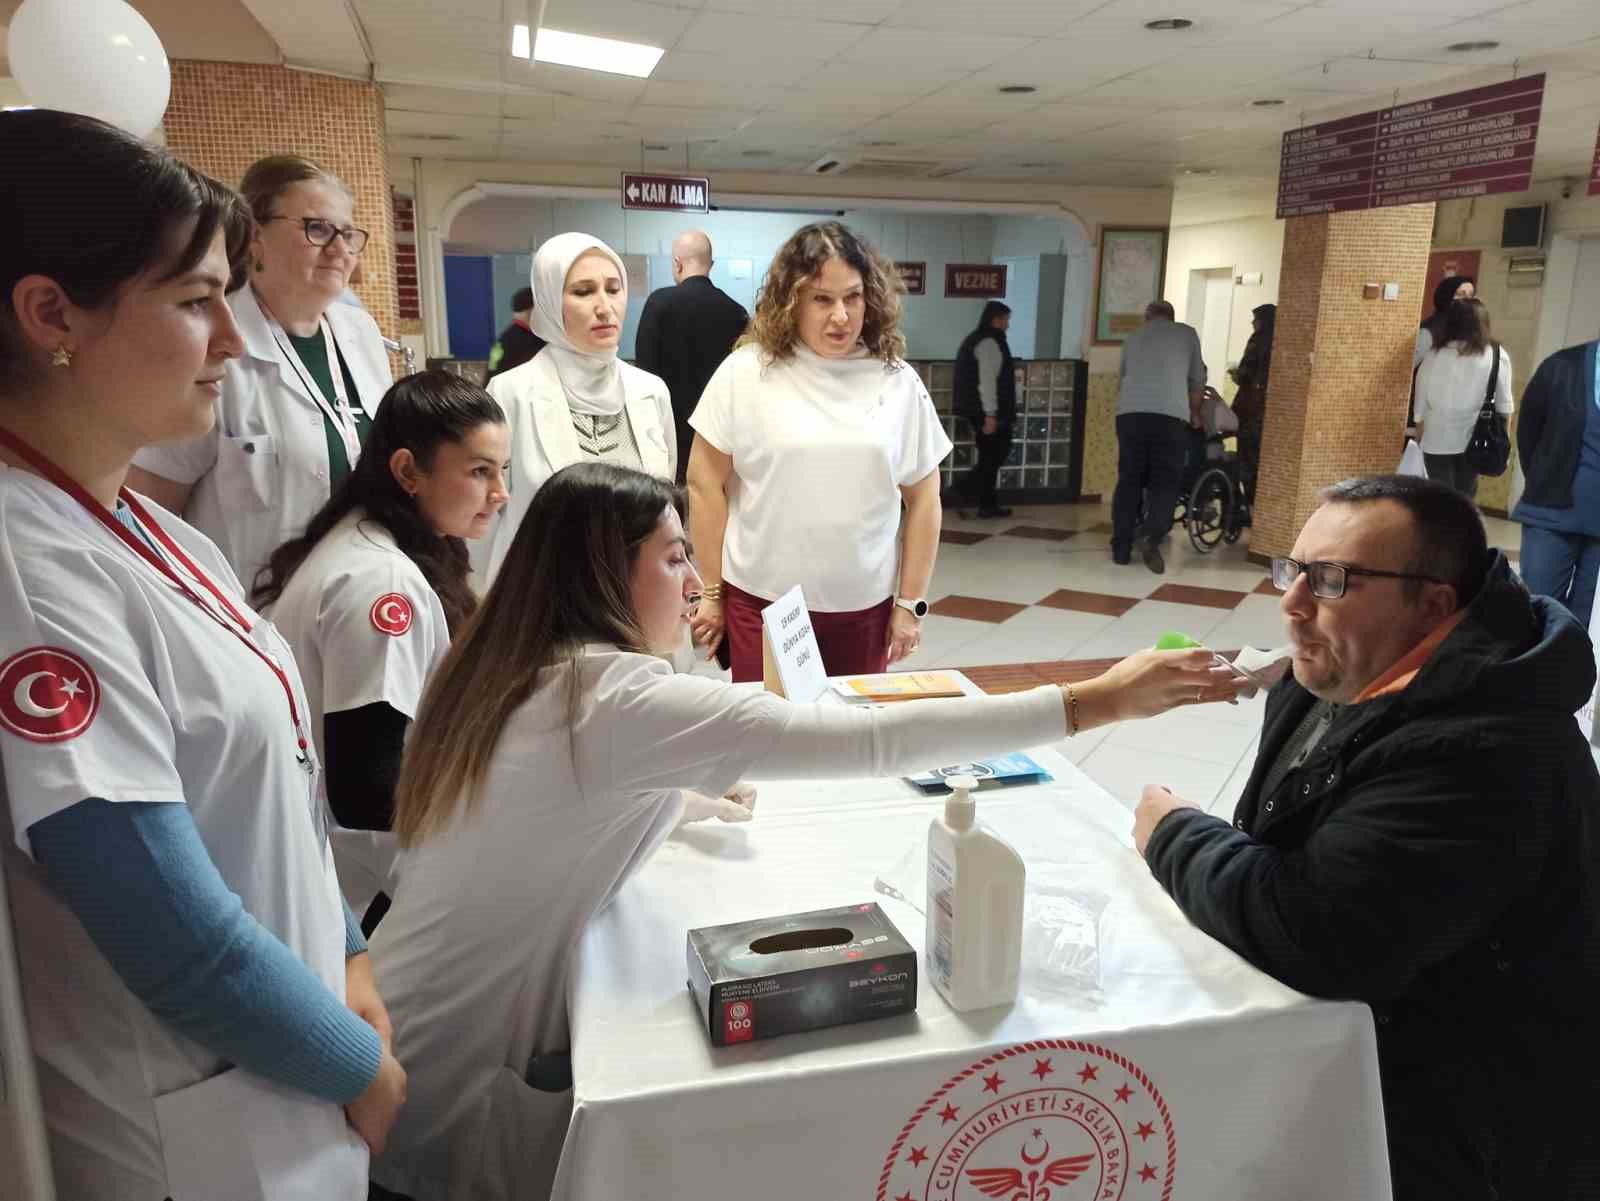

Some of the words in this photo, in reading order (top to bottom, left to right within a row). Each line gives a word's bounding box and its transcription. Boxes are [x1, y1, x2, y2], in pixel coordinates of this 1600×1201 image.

[641, 183, 666, 204] KAN
[670, 185, 704, 206] ALMA
[954, 271, 1000, 289] VEZNE
[782, 632, 798, 654] DÜNYA
[727, 1018, 752, 1032] 100
[936, 1093, 1057, 1190] CUMHURİYETİ
[1062, 1097, 1116, 1146] SAĞLIK
